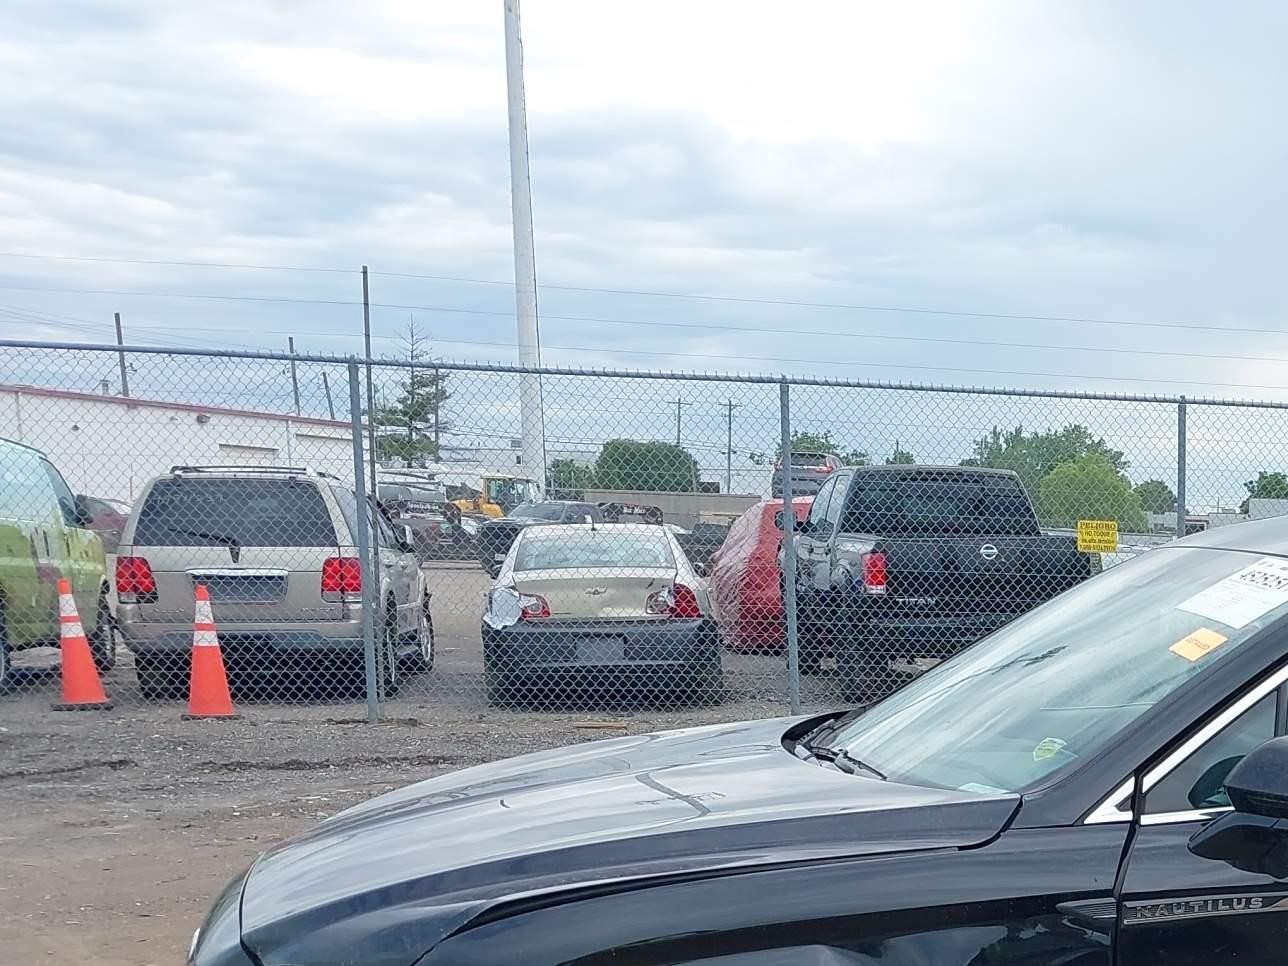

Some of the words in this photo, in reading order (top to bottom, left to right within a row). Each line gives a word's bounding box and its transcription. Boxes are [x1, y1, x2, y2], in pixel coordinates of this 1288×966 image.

[1079, 522, 1116, 530] PELIGRO
[895, 597, 937, 606] TITAN
[1136, 897, 1263, 919] NAUTILUS
